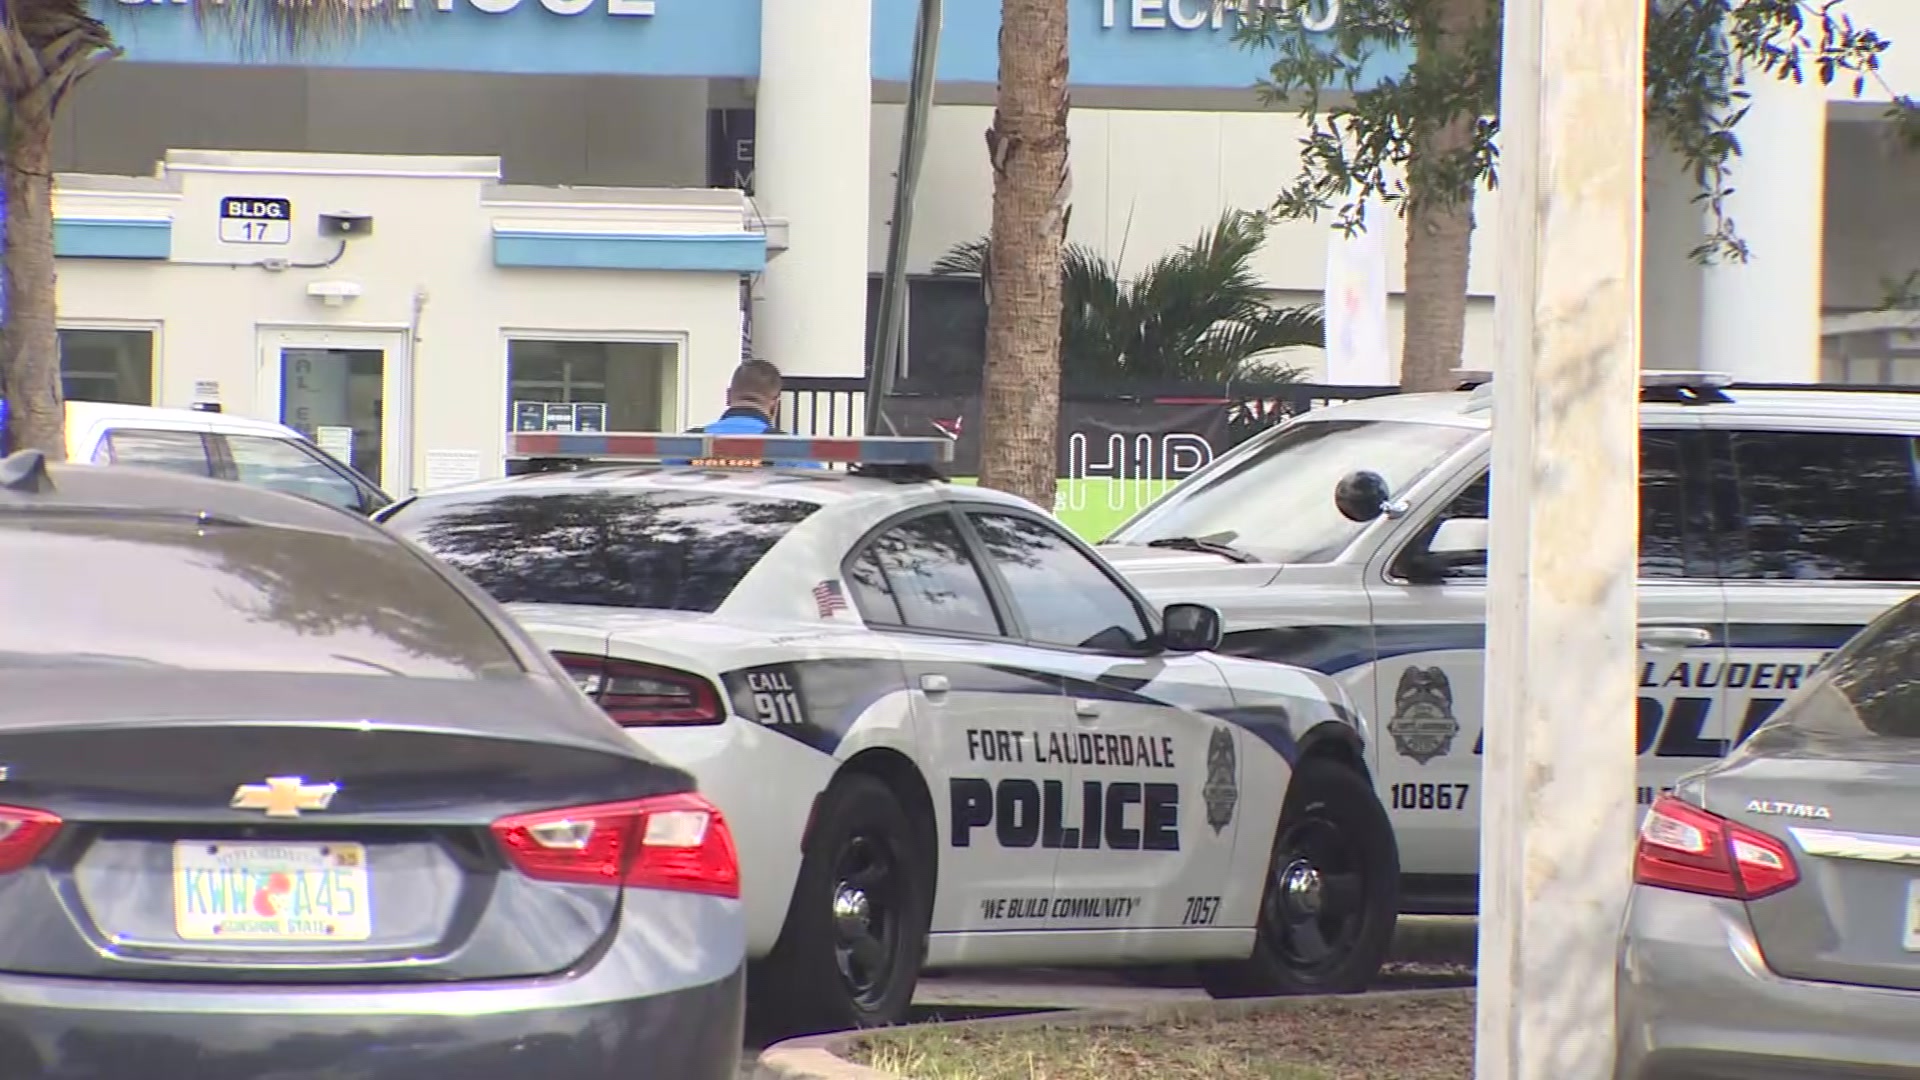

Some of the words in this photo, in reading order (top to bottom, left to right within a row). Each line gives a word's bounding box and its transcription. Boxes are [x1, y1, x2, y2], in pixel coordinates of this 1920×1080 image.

[243, 221, 269, 241] 17
[747, 672, 793, 691] CALL
[1637, 661, 1819, 689] LAUDER
[754, 692, 803, 724] 911
[967, 729, 1024, 762] FORT
[1033, 731, 1176, 768] LAUDERDALE
[1391, 783, 1470, 810] 10867
[1745, 800, 1831, 819] ALTIMA
[949, 777, 1180, 851] POLICE
[294, 868, 355, 916] A45
[1007, 898, 1050, 918] BUILD
[1182, 895, 1221, 925] 7057
